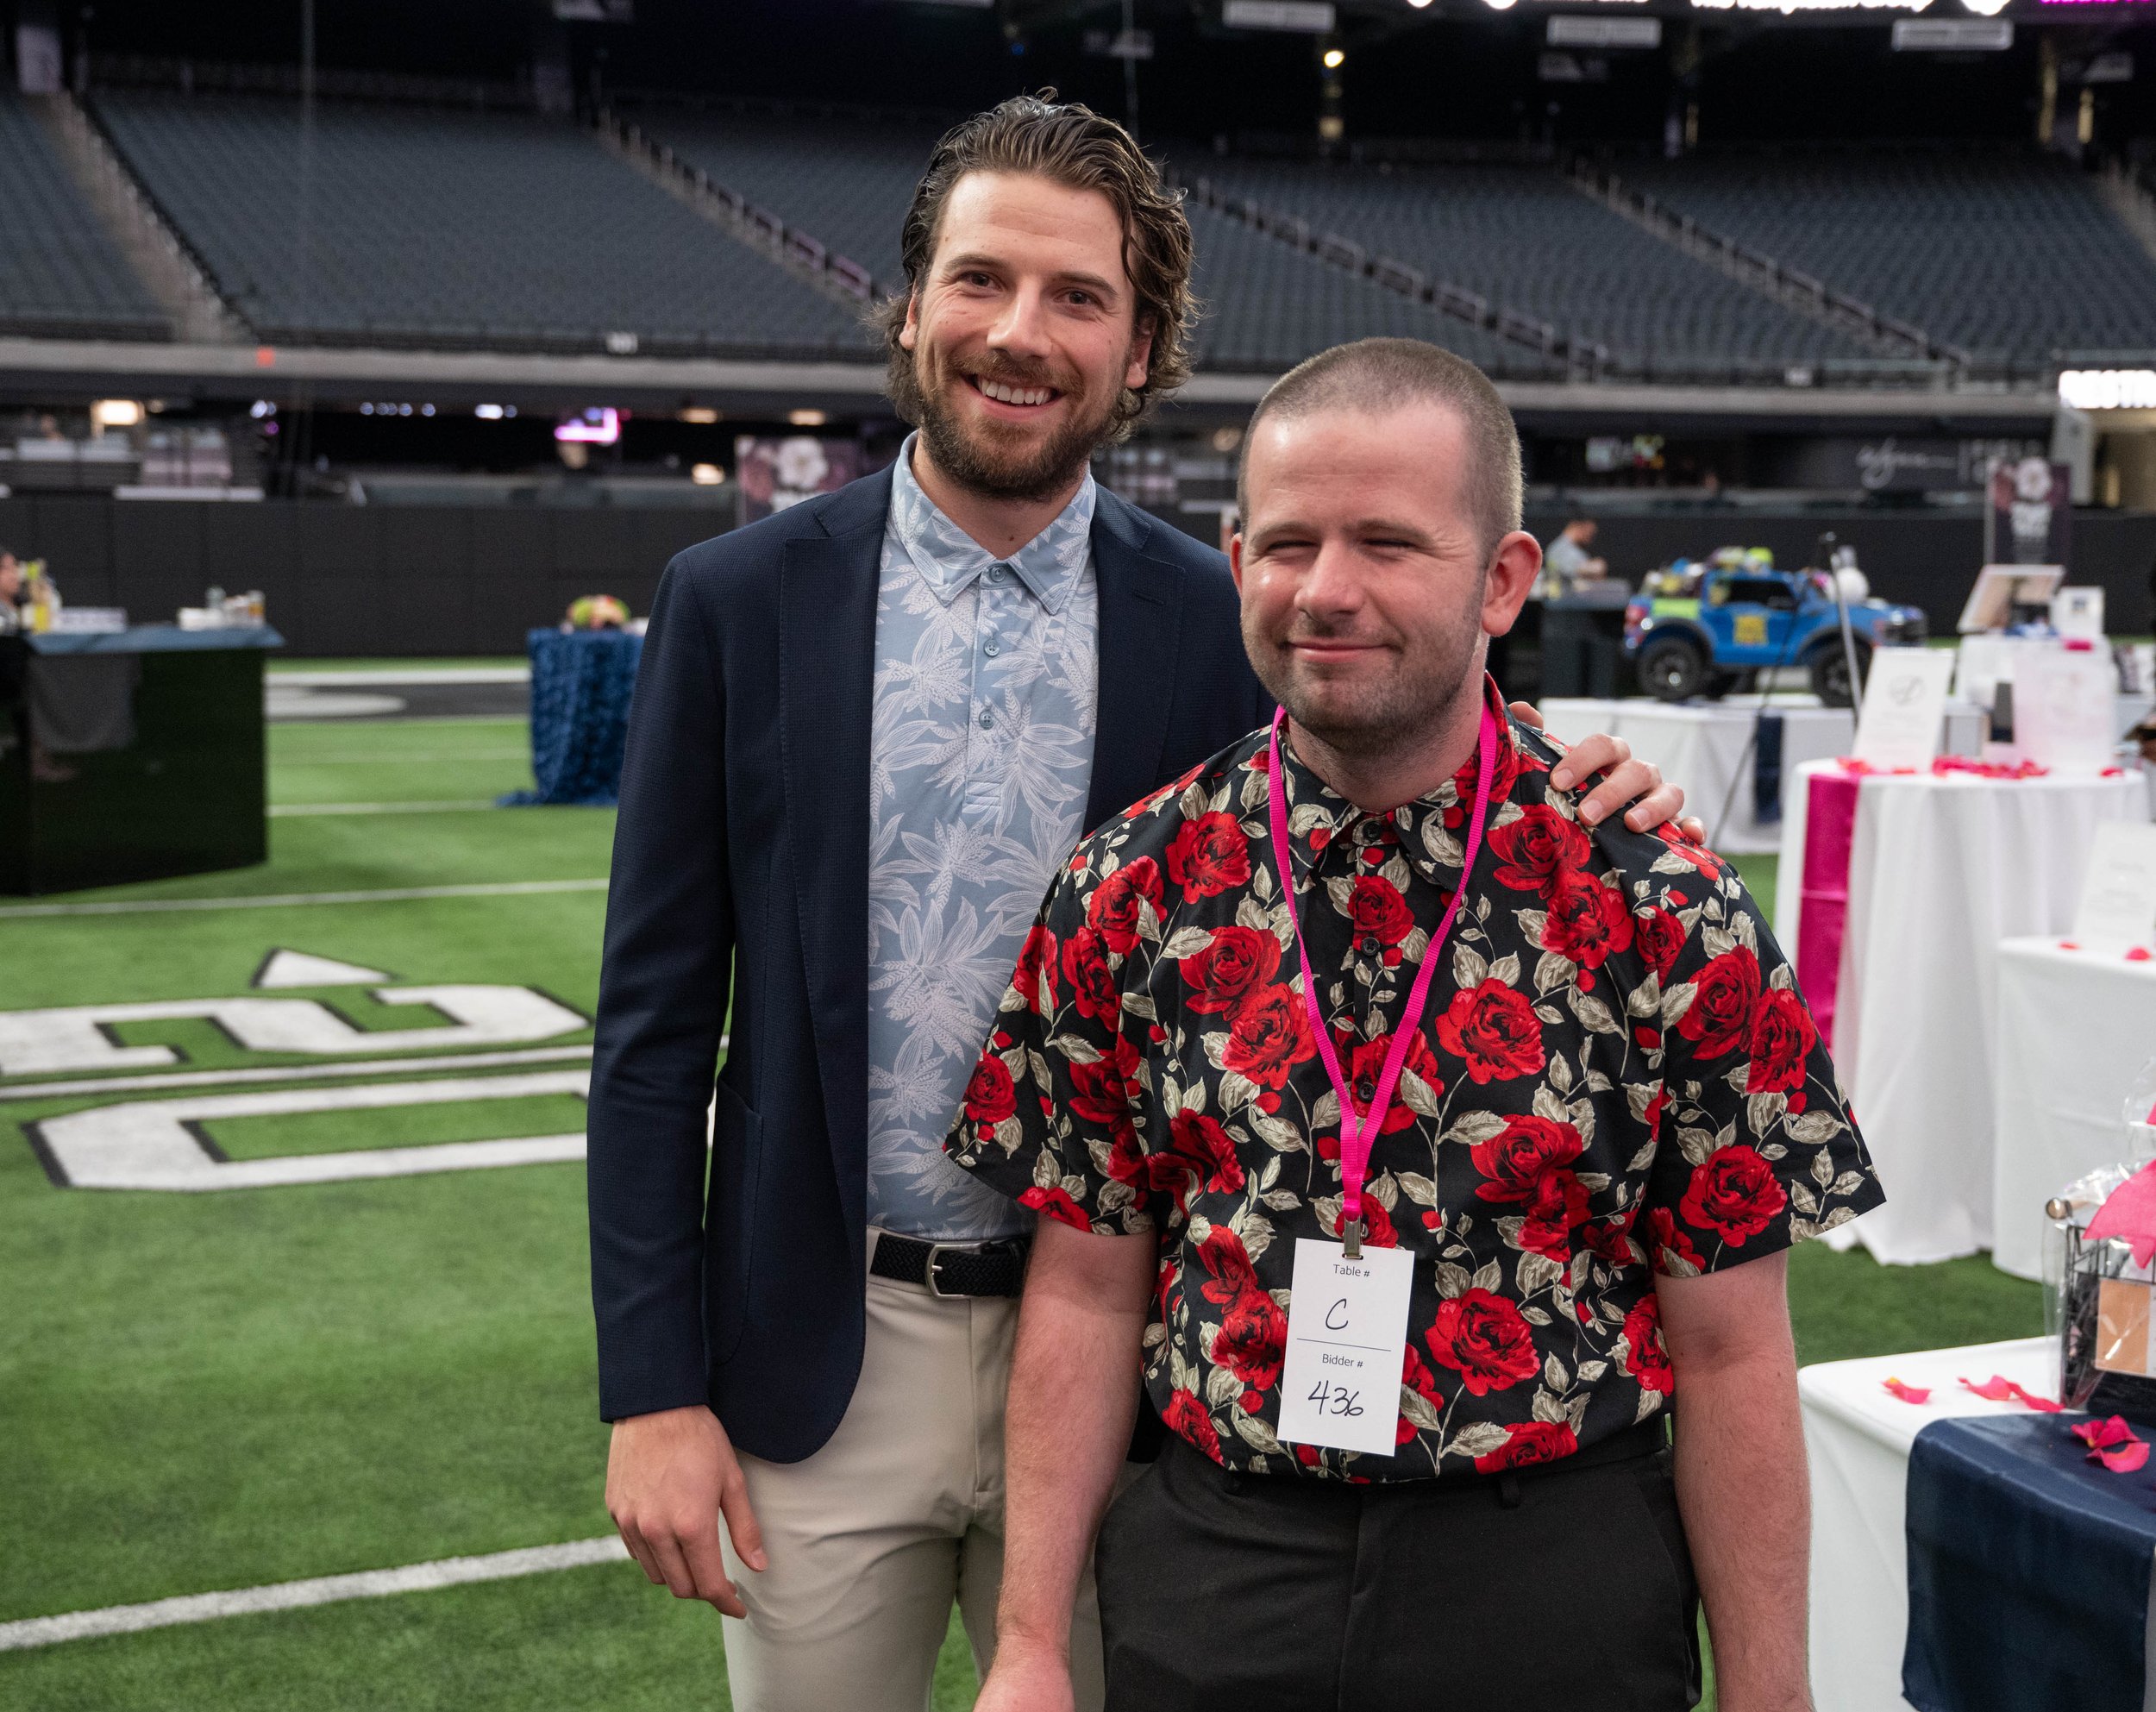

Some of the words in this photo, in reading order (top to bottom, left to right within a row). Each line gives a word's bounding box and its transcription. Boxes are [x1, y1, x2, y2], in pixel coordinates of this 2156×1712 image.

[1333, 1264, 1361, 1277] Table
[1325, 1298, 1349, 1331] C
[1322, 1353, 1354, 1367] Bidder
[1307, 1379, 1364, 1417] 436
